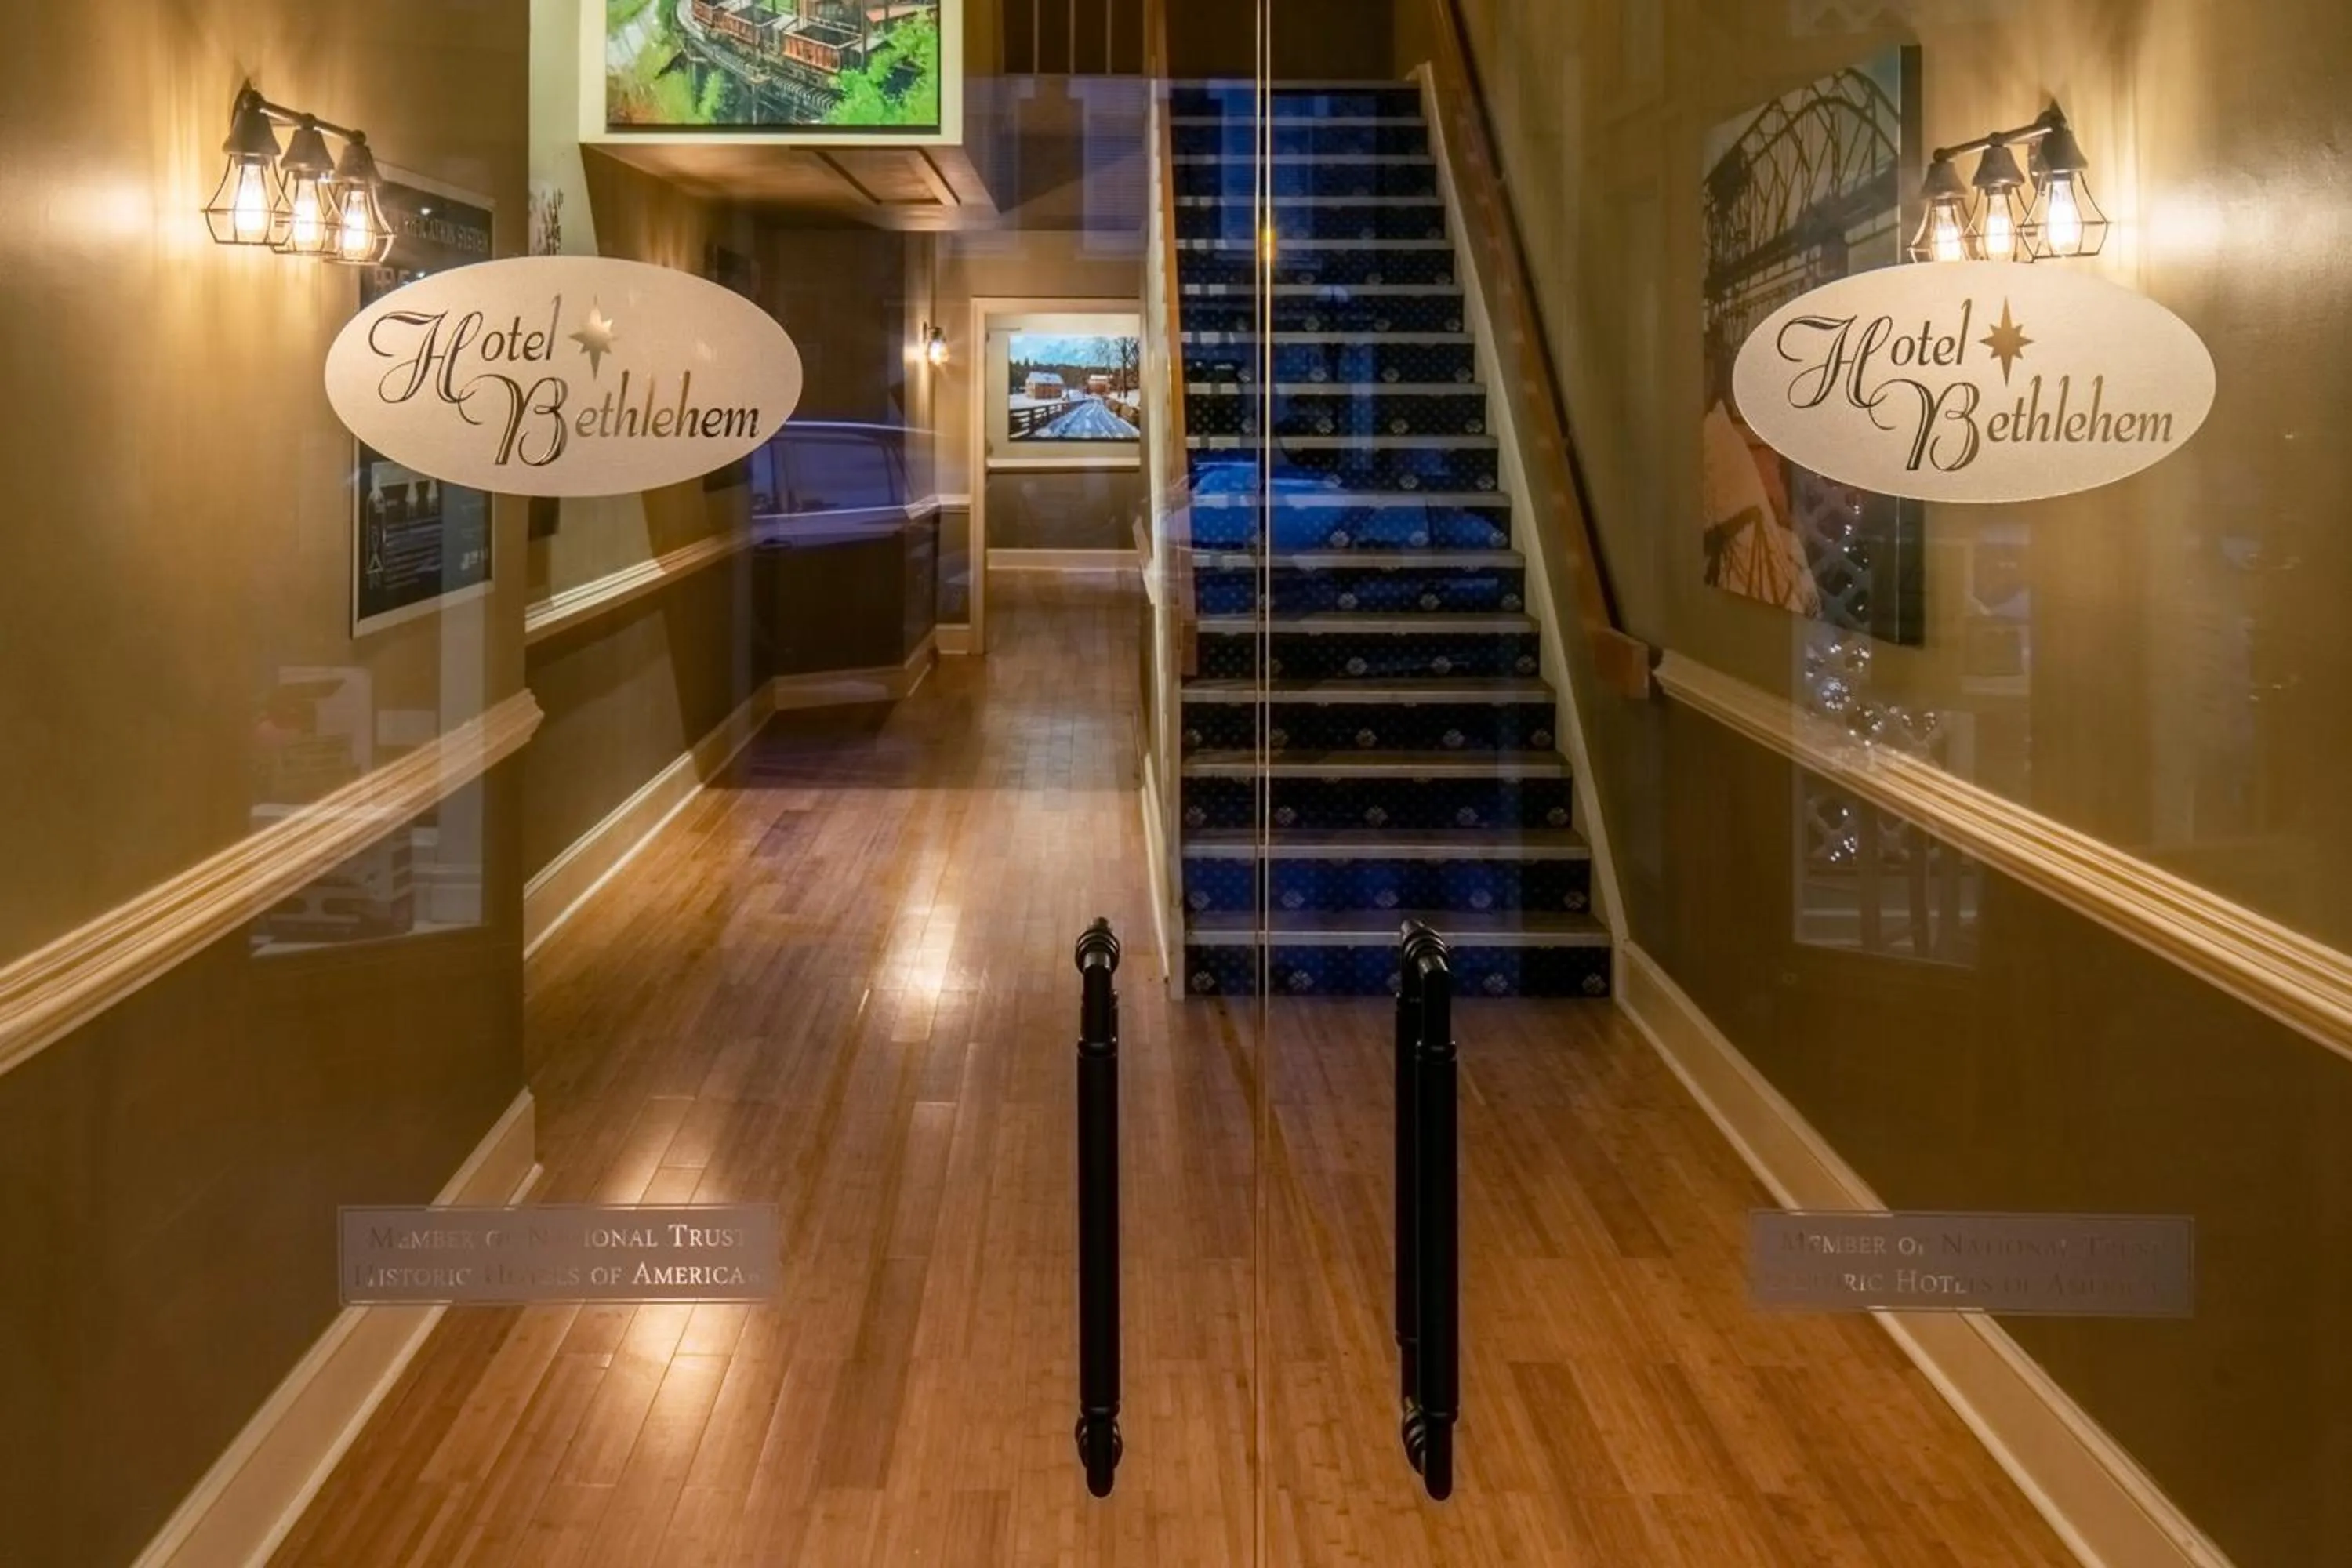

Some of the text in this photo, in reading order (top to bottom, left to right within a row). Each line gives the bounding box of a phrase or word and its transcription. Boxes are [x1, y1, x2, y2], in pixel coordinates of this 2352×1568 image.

[368, 293, 561, 405] Hotel
[1777, 298, 1972, 409] Hotel
[459, 370, 760, 466] Bethlehem
[1869, 375, 2172, 472] Bethlehem
[527, 1225, 659, 1248] NIONAL
